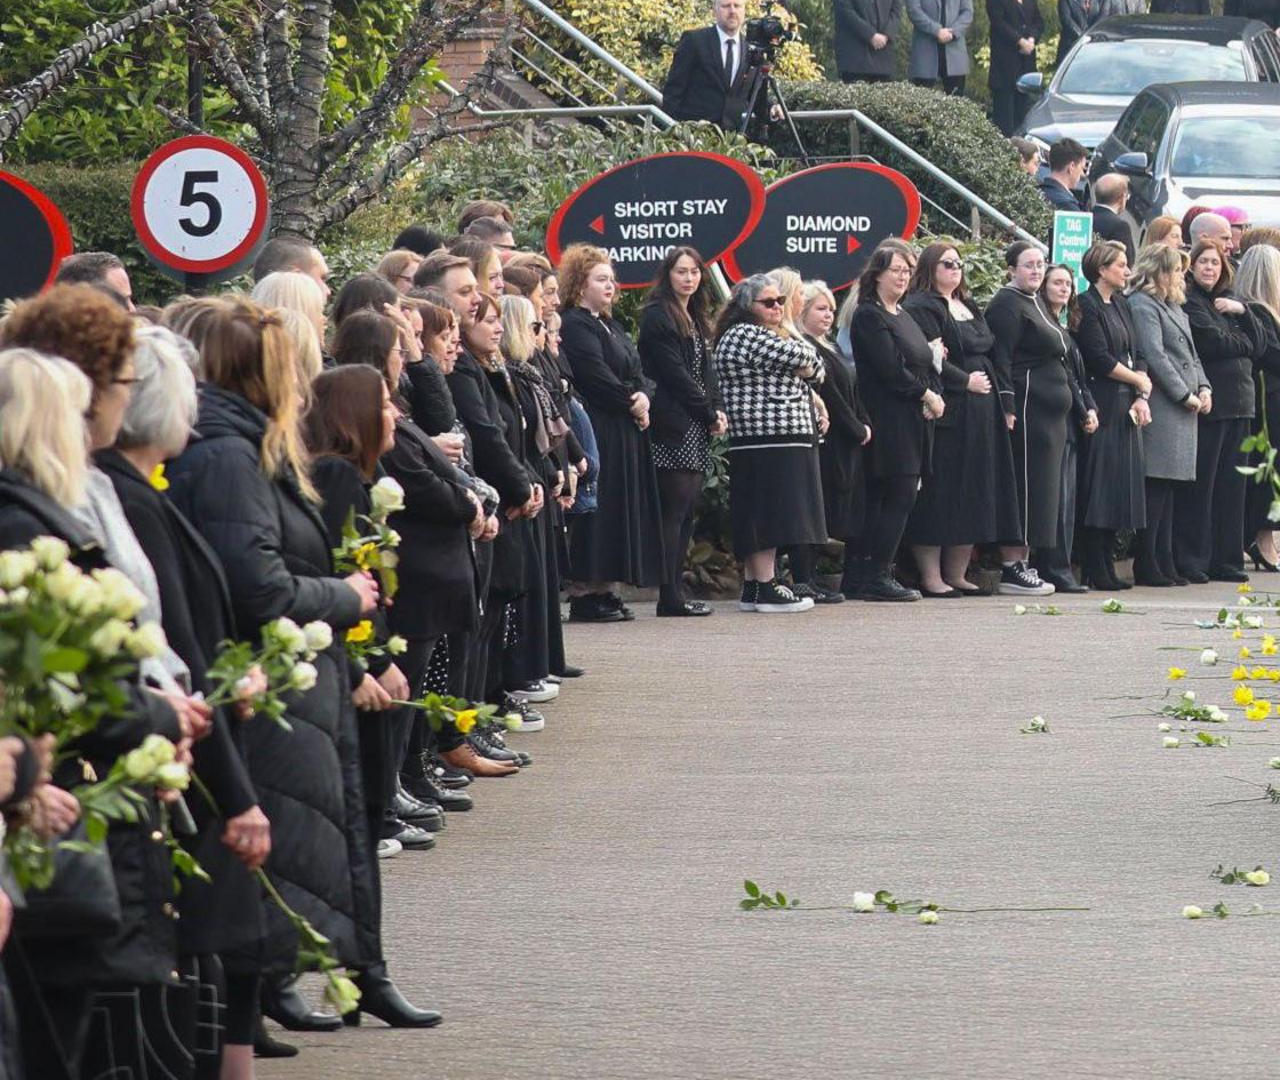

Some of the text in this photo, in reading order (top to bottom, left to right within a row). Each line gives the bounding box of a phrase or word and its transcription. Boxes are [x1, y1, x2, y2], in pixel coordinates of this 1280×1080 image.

[179, 170, 222, 237] 5
[614, 199, 728, 218] SHORT STAY
[620, 222, 693, 239] VISITOR
[786, 215, 871, 232] DIAMOND
[786, 237, 837, 253] SUITE
